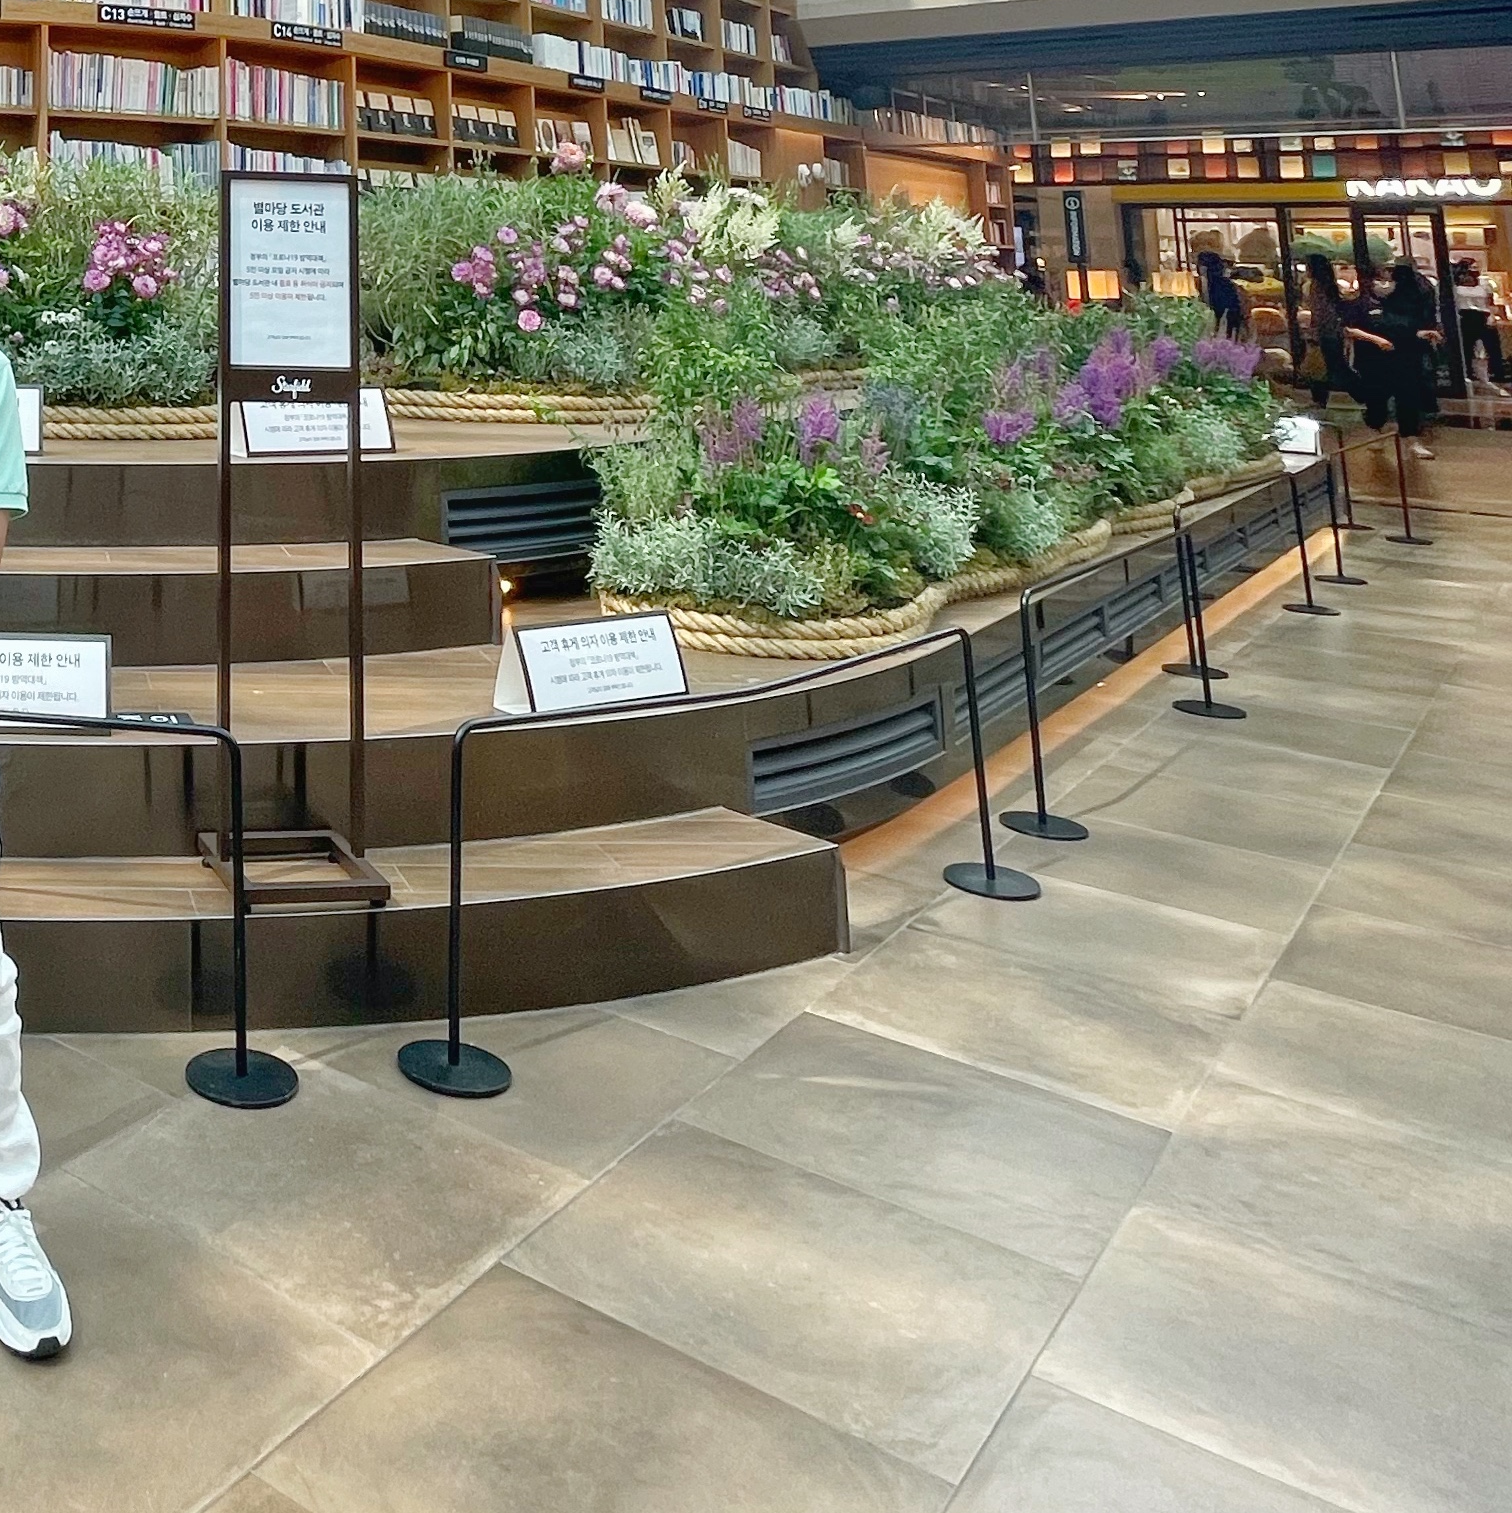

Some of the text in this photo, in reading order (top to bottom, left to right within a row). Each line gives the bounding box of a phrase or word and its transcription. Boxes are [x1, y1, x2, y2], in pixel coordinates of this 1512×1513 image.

[101, 6, 125, 20] C13
[273, 23, 292, 37] C14
[253, 201, 325, 217] 별마당 도서관
[251, 218, 326, 234] 이용 제한 안내
[540, 627, 657, 653] 고객 휴게 의자 이용 제한 안내
[0, 652, 24, 666] 이용
[27, 653, 52, 667] 제한
[56, 653, 81, 668] 안내
[11, 691, 36, 701] 이용이
